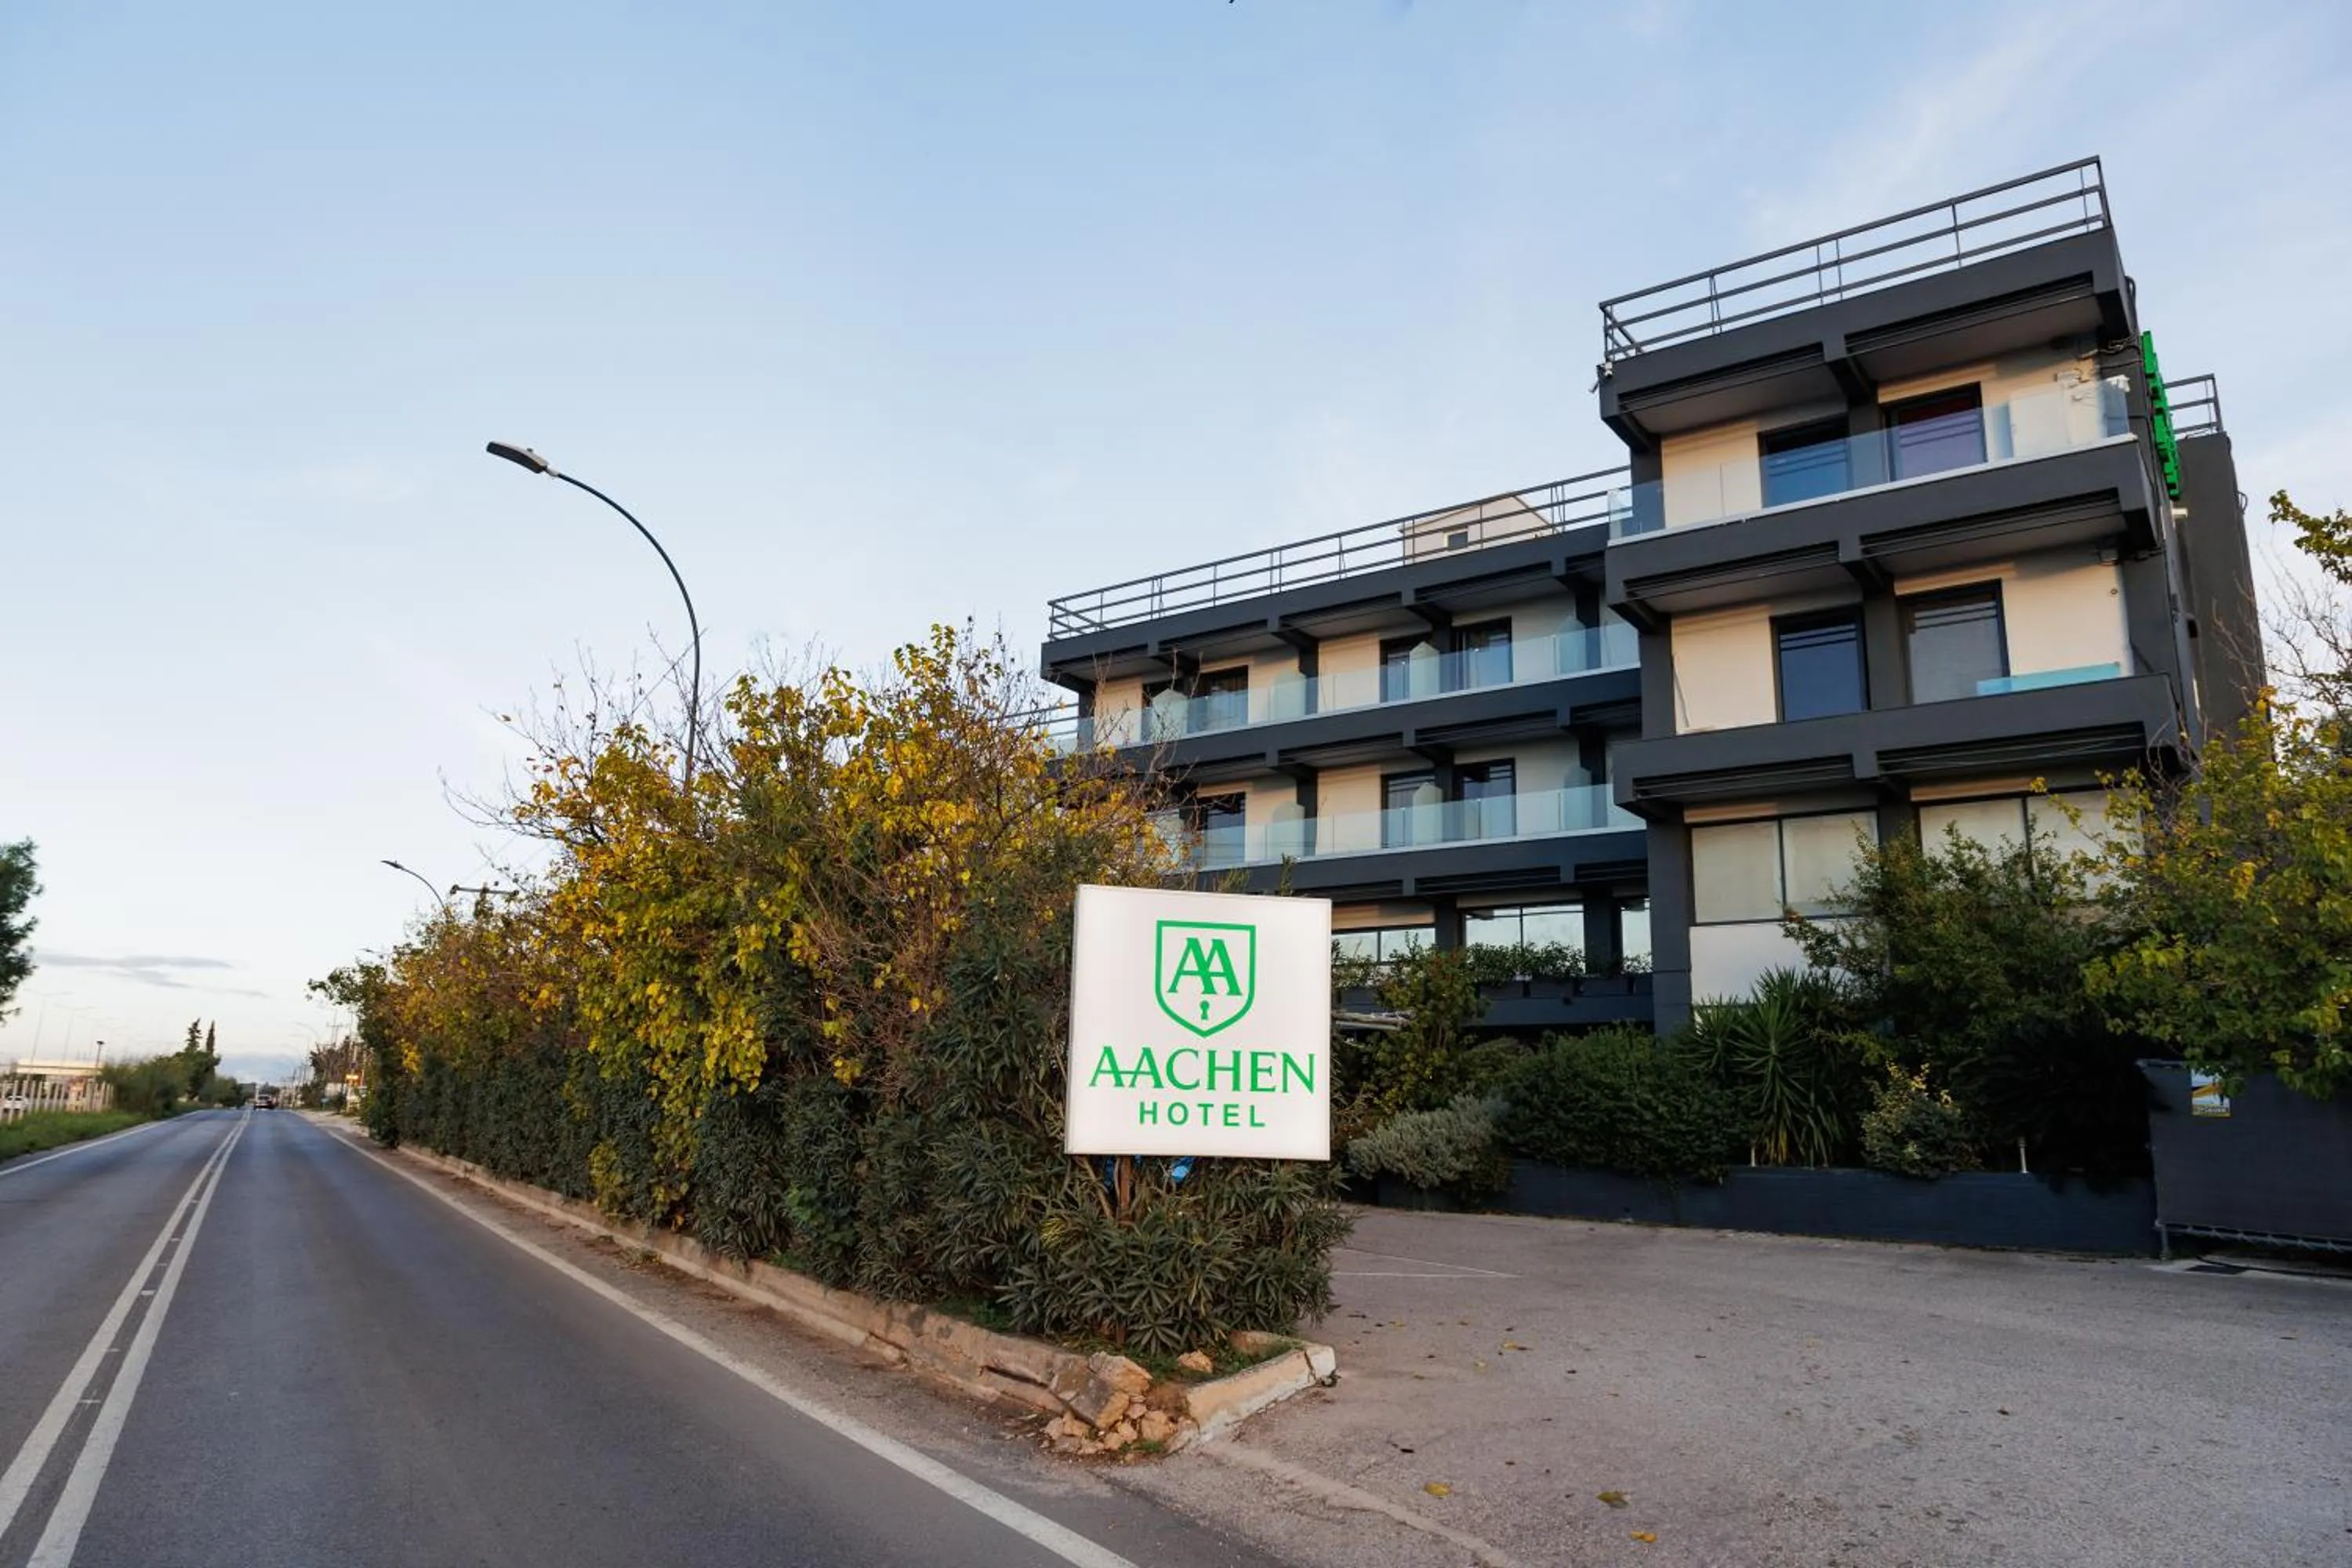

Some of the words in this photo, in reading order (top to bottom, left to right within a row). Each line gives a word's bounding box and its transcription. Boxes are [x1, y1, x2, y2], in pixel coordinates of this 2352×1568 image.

[1167, 937, 1243, 996] AA
[1089, 1045, 1316, 1094] AACHEN
[1138, 1101, 1265, 1128] HOTEL
